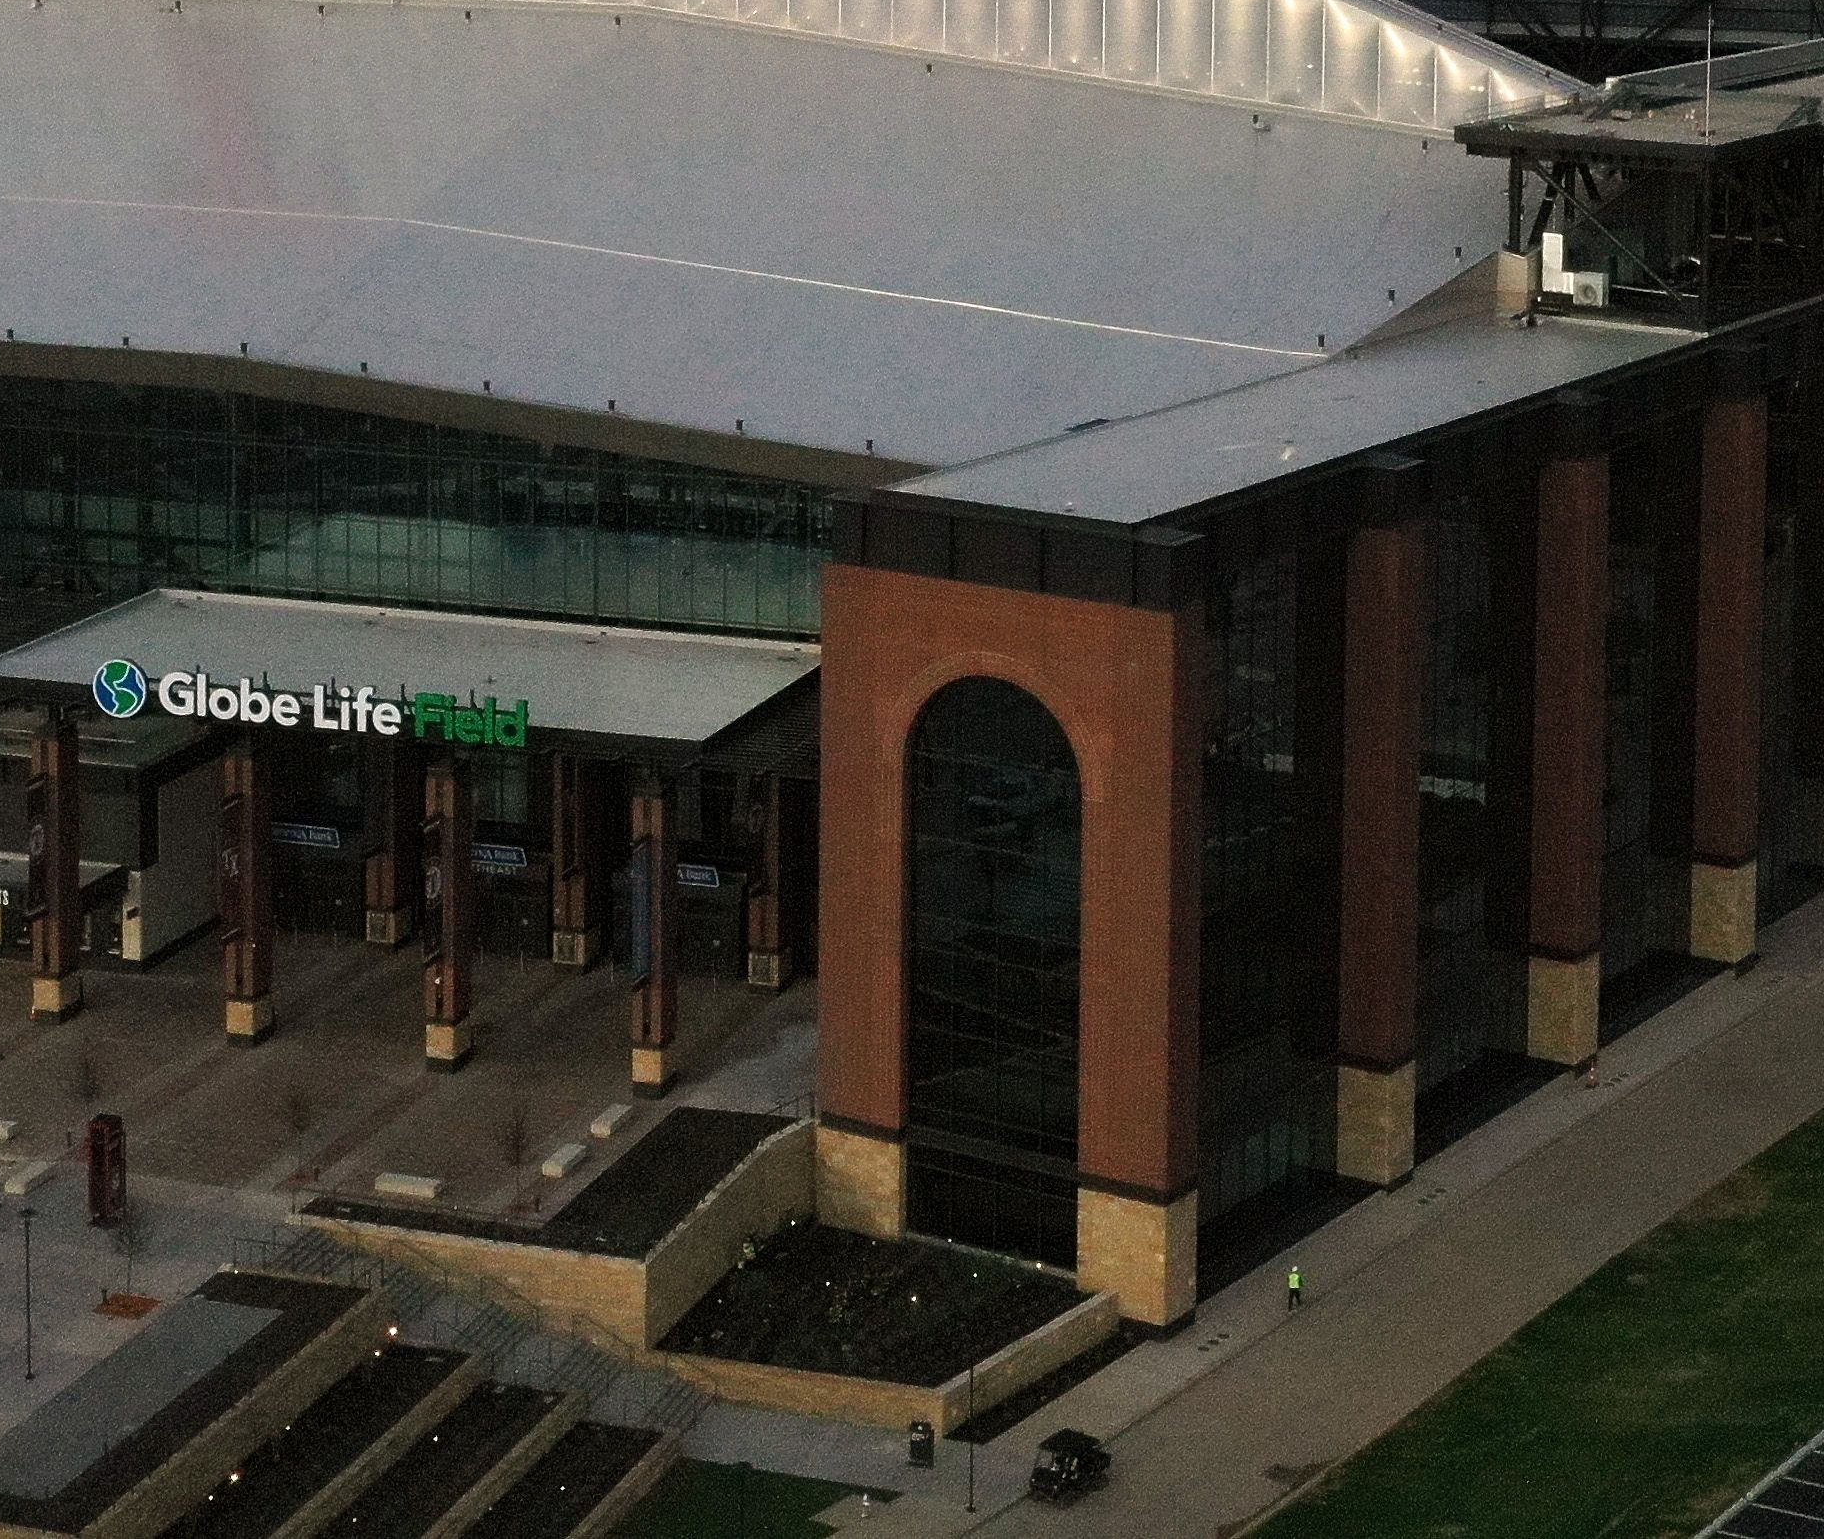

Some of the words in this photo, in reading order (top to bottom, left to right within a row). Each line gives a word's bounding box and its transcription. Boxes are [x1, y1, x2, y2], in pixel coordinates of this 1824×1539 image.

[158, 671, 300, 726] Globe
[313, 684, 402, 736] Life
[413, 692, 529, 747] Field
